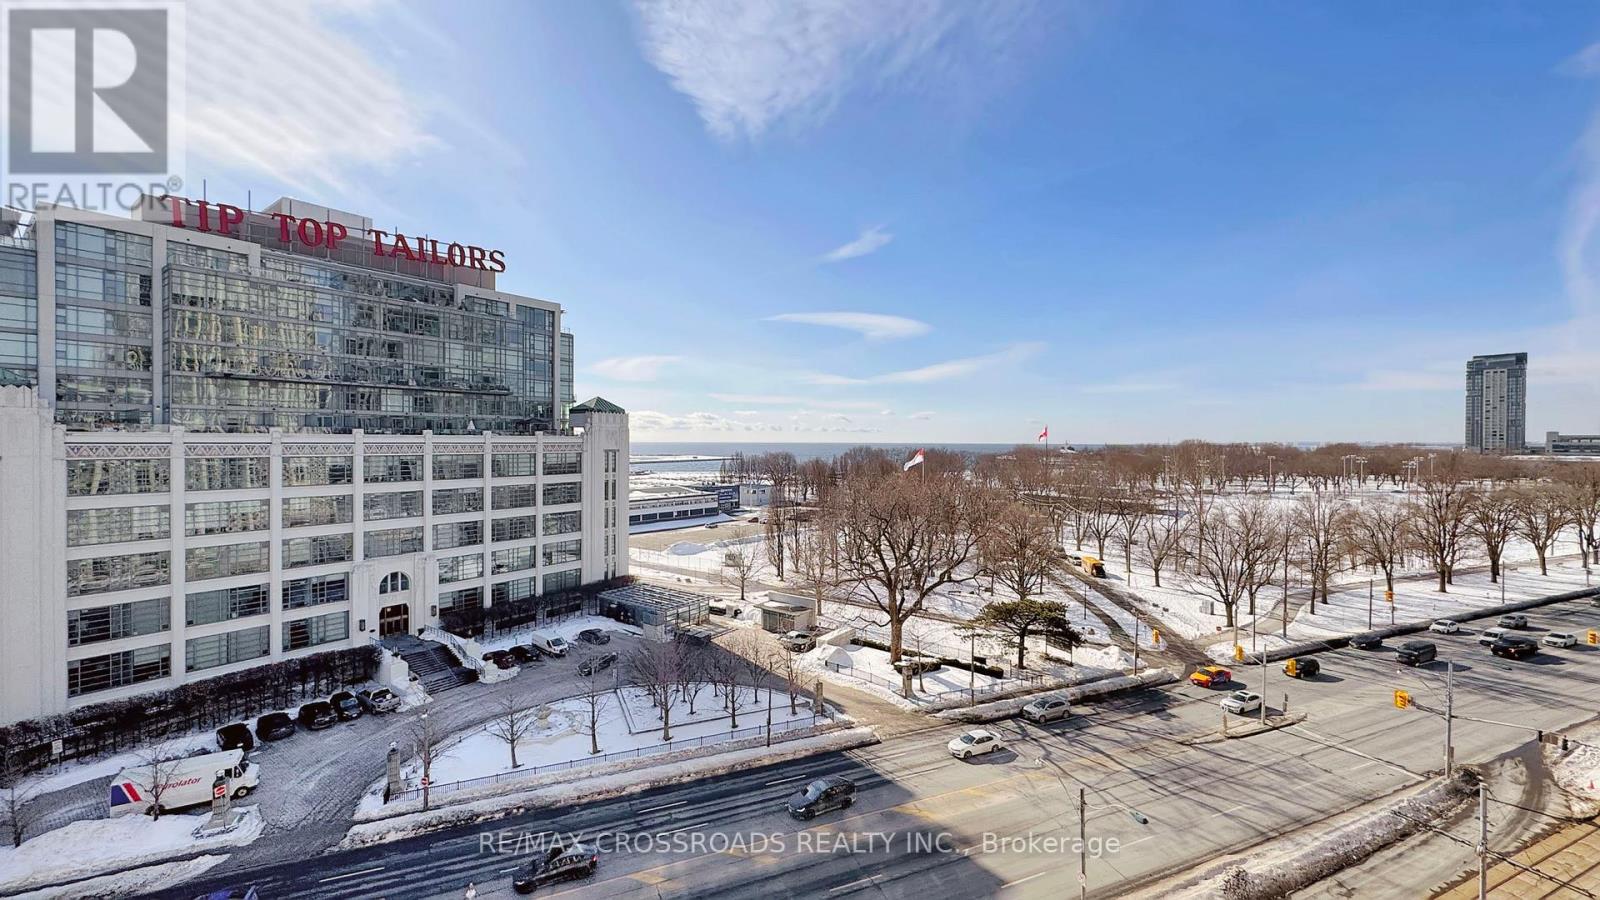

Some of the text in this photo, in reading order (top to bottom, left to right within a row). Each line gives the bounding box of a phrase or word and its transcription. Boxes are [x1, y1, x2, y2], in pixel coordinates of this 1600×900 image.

[160, 194, 506, 273] TIP TOP TAILORS
